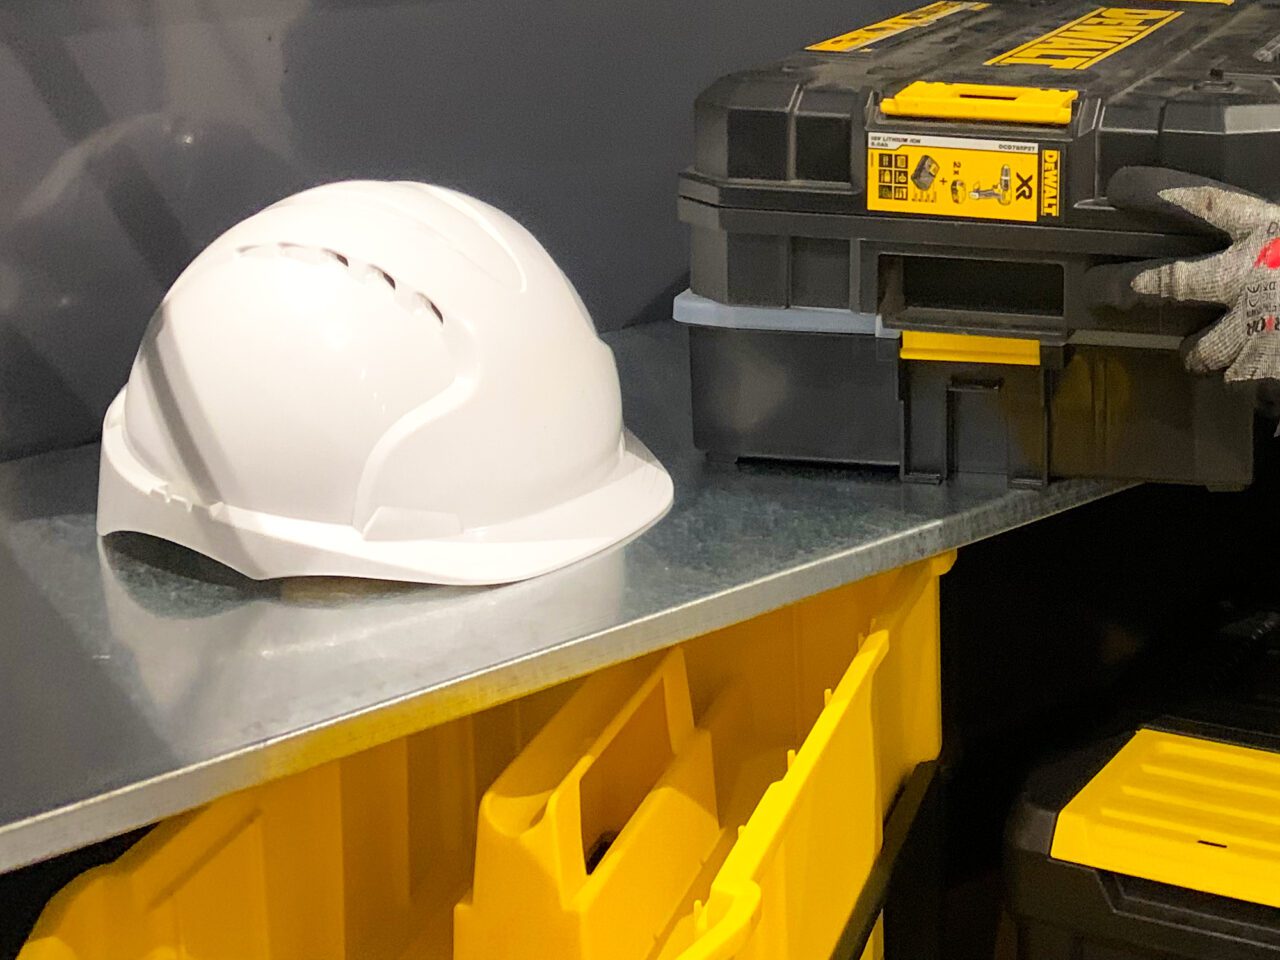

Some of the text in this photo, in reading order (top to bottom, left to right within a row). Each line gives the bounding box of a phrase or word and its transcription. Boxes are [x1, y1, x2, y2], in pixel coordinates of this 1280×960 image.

[995, 7, 1175, 69] DEWALT
[1016, 172, 1033, 201] XR
[1043, 150, 1060, 217] DEWALT
